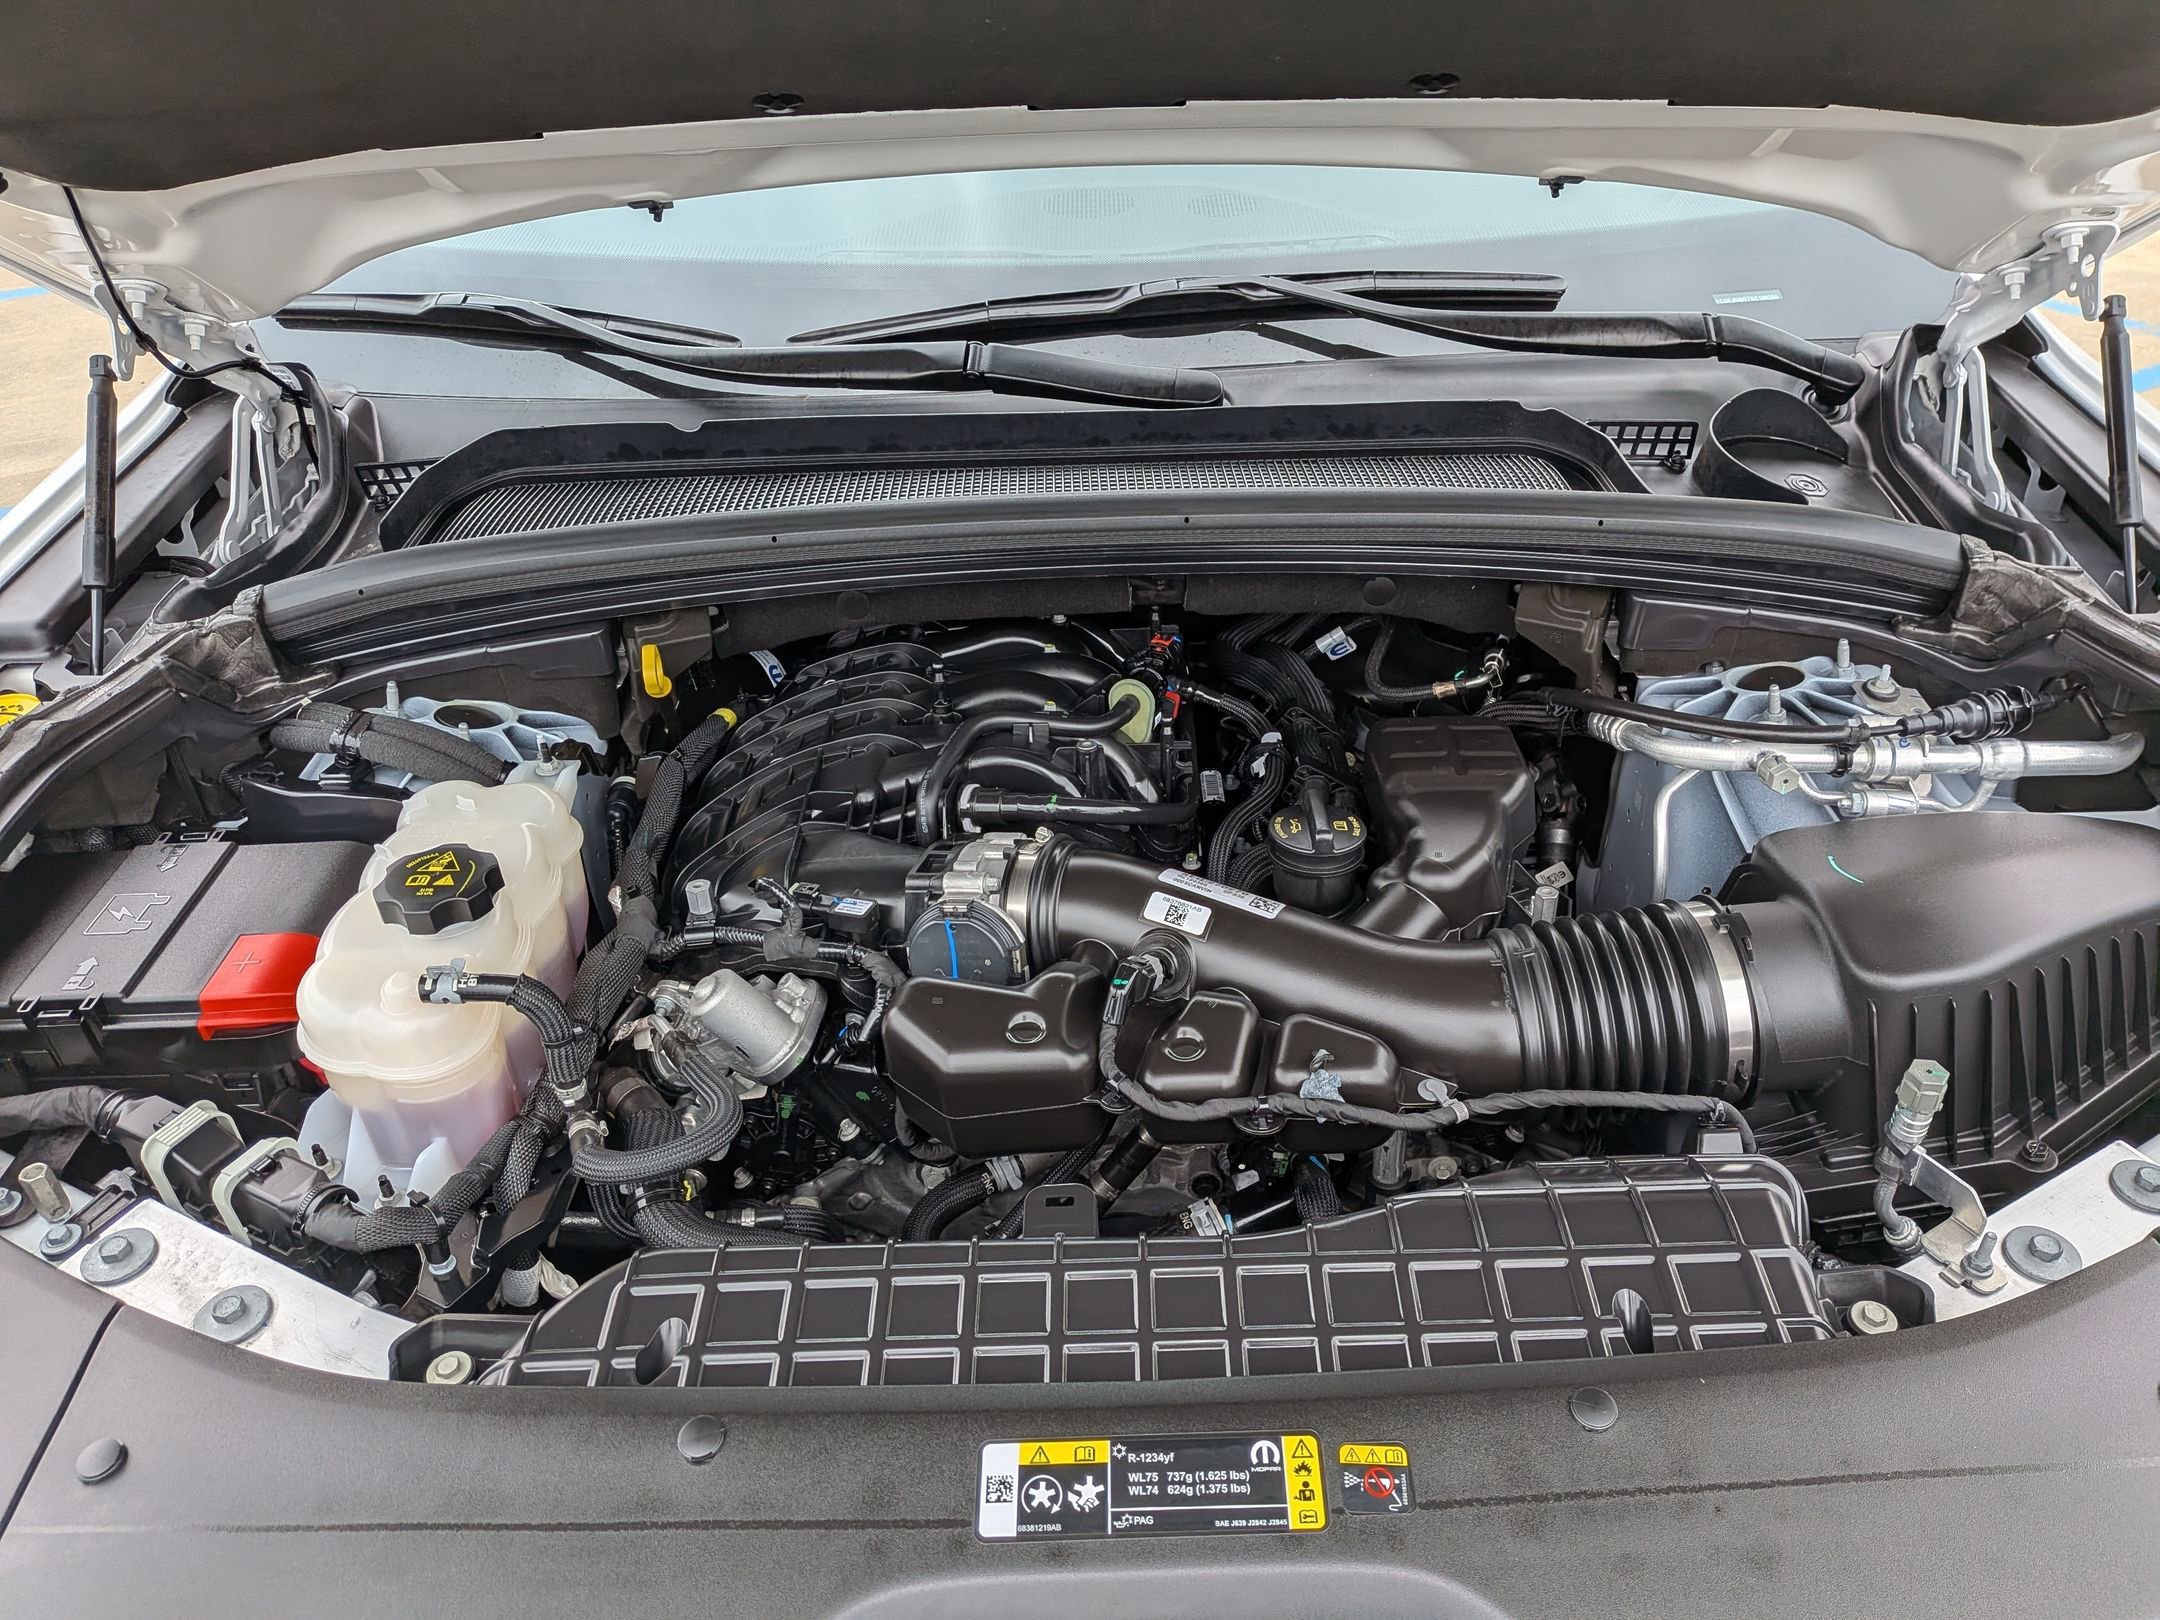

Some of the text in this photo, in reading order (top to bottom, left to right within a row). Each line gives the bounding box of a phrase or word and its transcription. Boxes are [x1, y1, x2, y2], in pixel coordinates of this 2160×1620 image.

[981, 1172, 995, 1195] ENG
[1179, 1211, 1193, 1230] ENG
[1127, 1452, 1175, 1465] R-1234yf
[1127, 1470, 1250, 1483] WL75 737g (1.625 lbs)
[1127, 1483, 1251, 1497] WL74 624g (1.375 lbs)
[1133, 1515, 1154, 1526] PAG
[1230, 1519, 1247, 1527] J639
[1247, 1519, 1267, 1527] J2842
[1267, 1518, 1288, 1526] J2845
